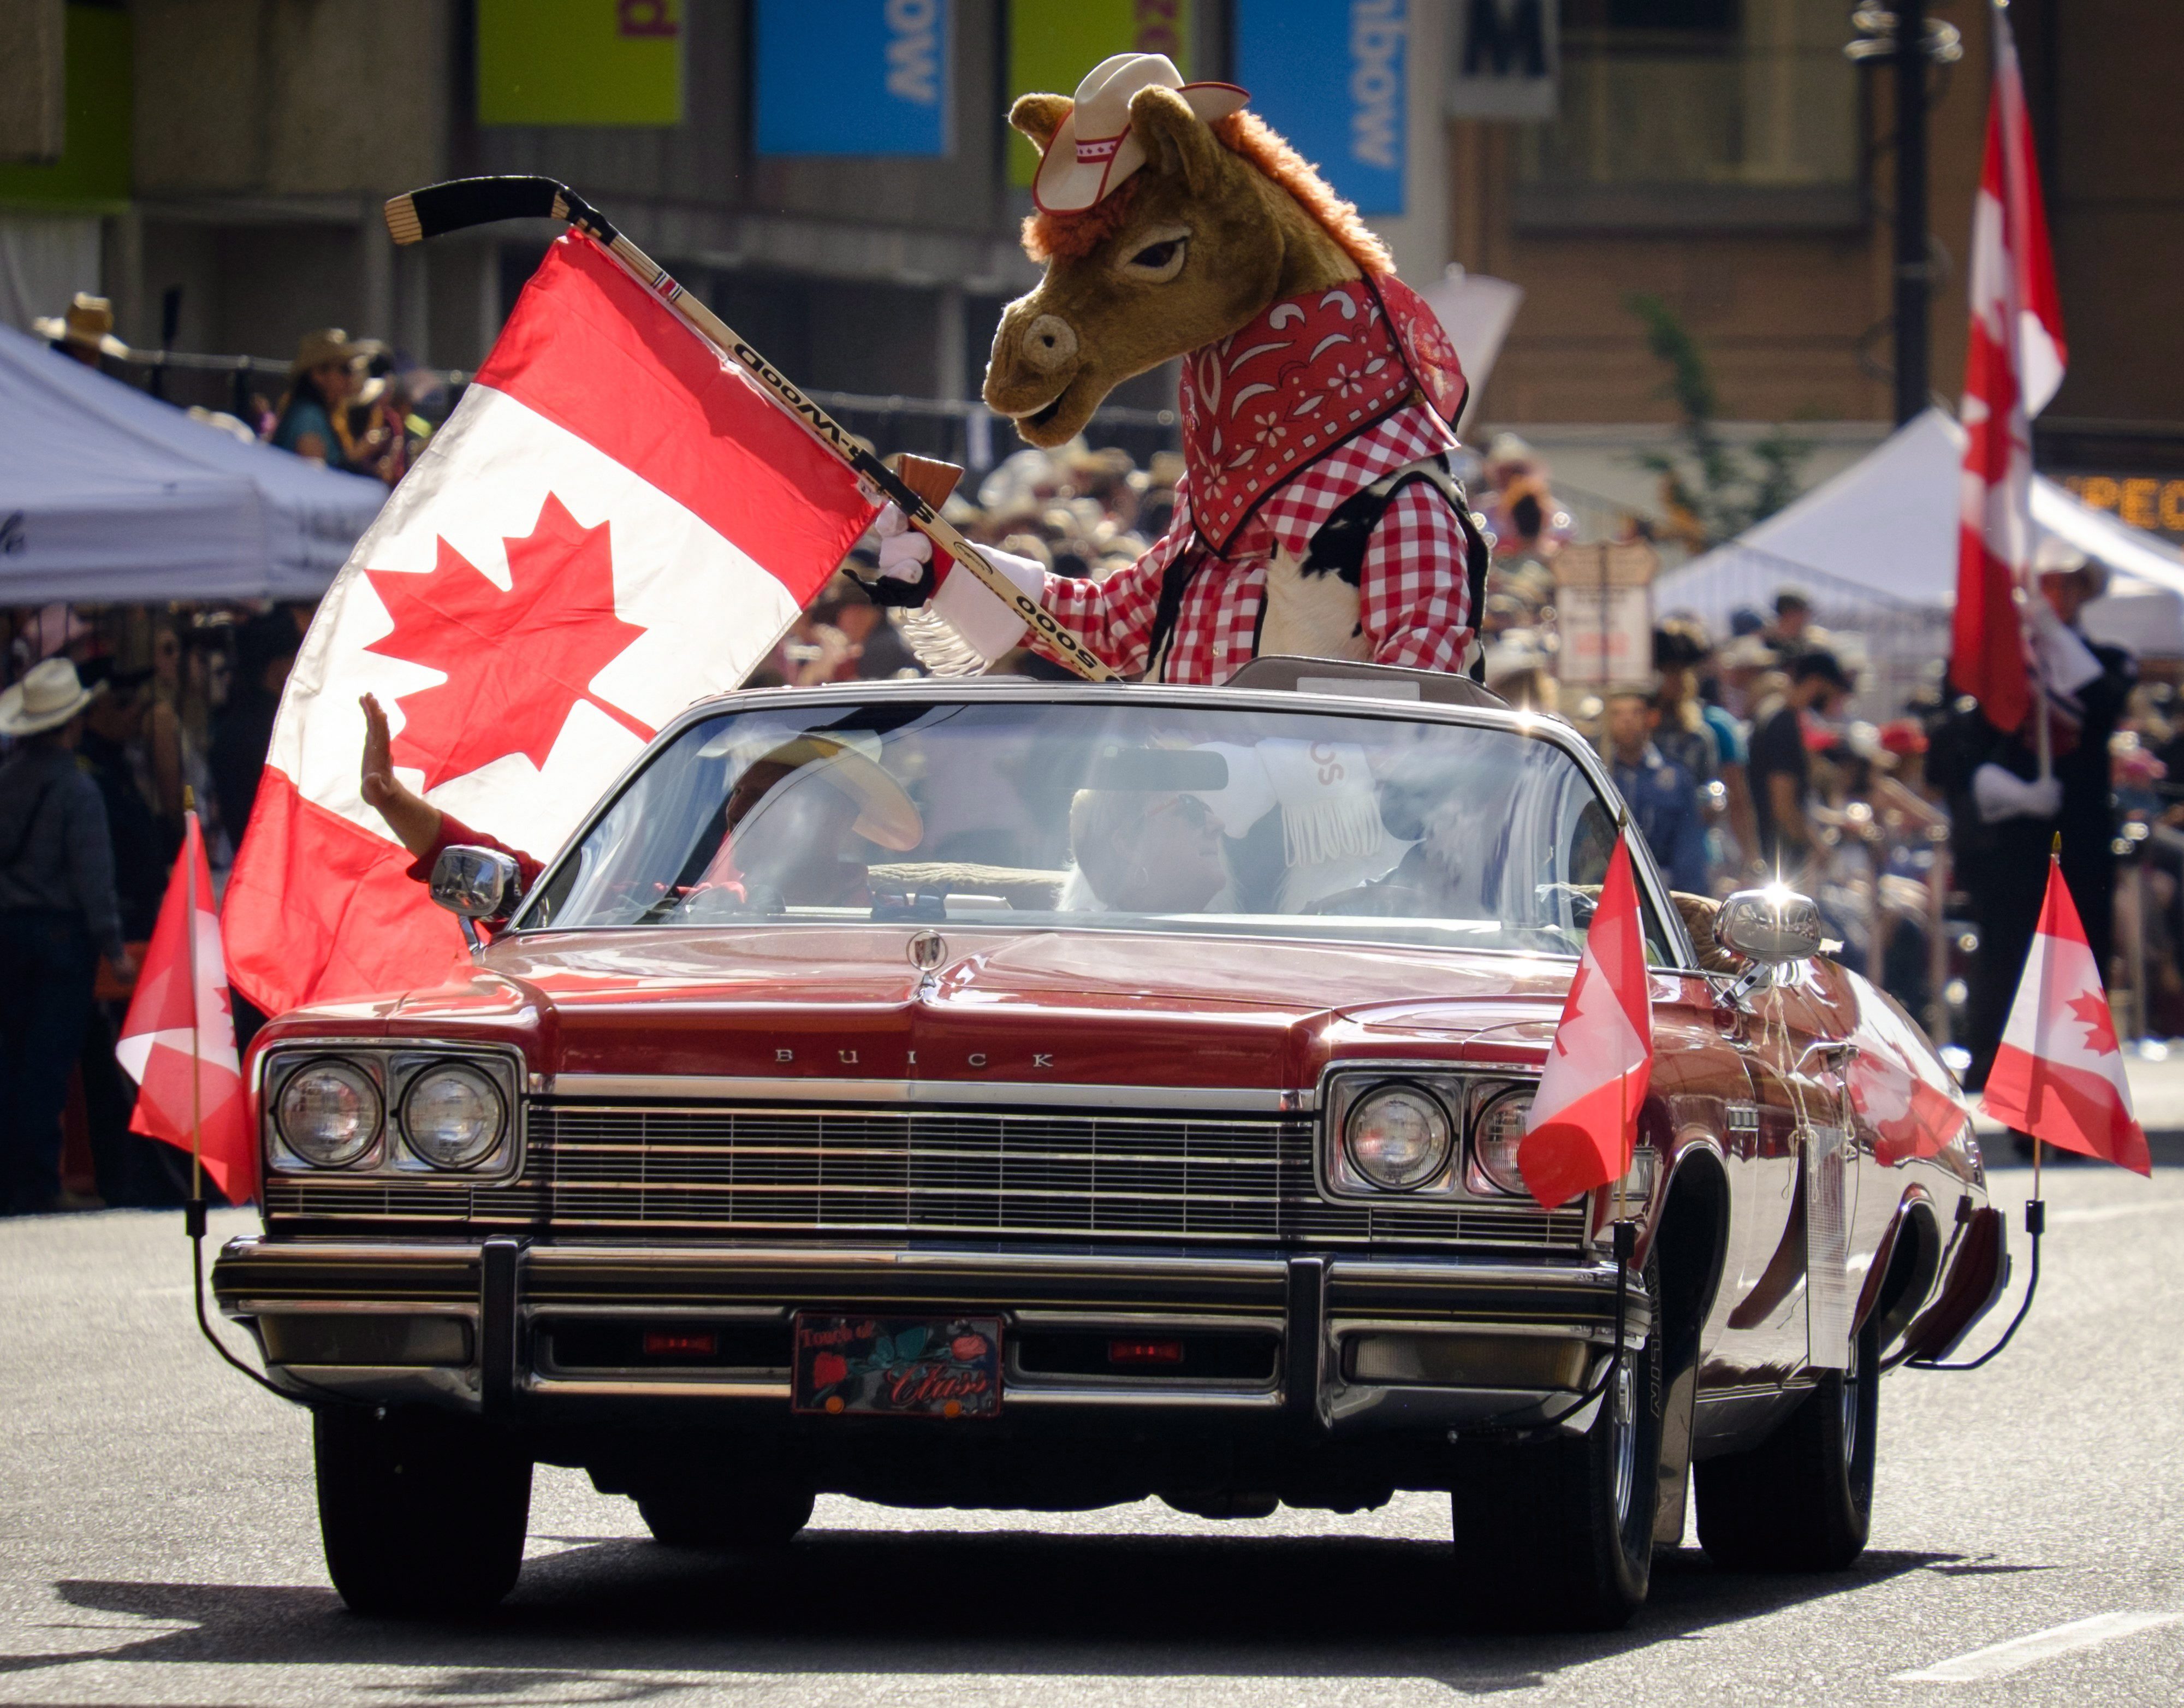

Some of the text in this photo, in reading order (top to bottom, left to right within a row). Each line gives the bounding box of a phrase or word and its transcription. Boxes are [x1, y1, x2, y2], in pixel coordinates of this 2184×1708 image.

[1016, 595, 1098, 669] 5000
[775, 1048, 1054, 1068] BUICK
[1648, 1247, 1661, 1419] ICHELIN
[885, 1361, 987, 1404] Class
